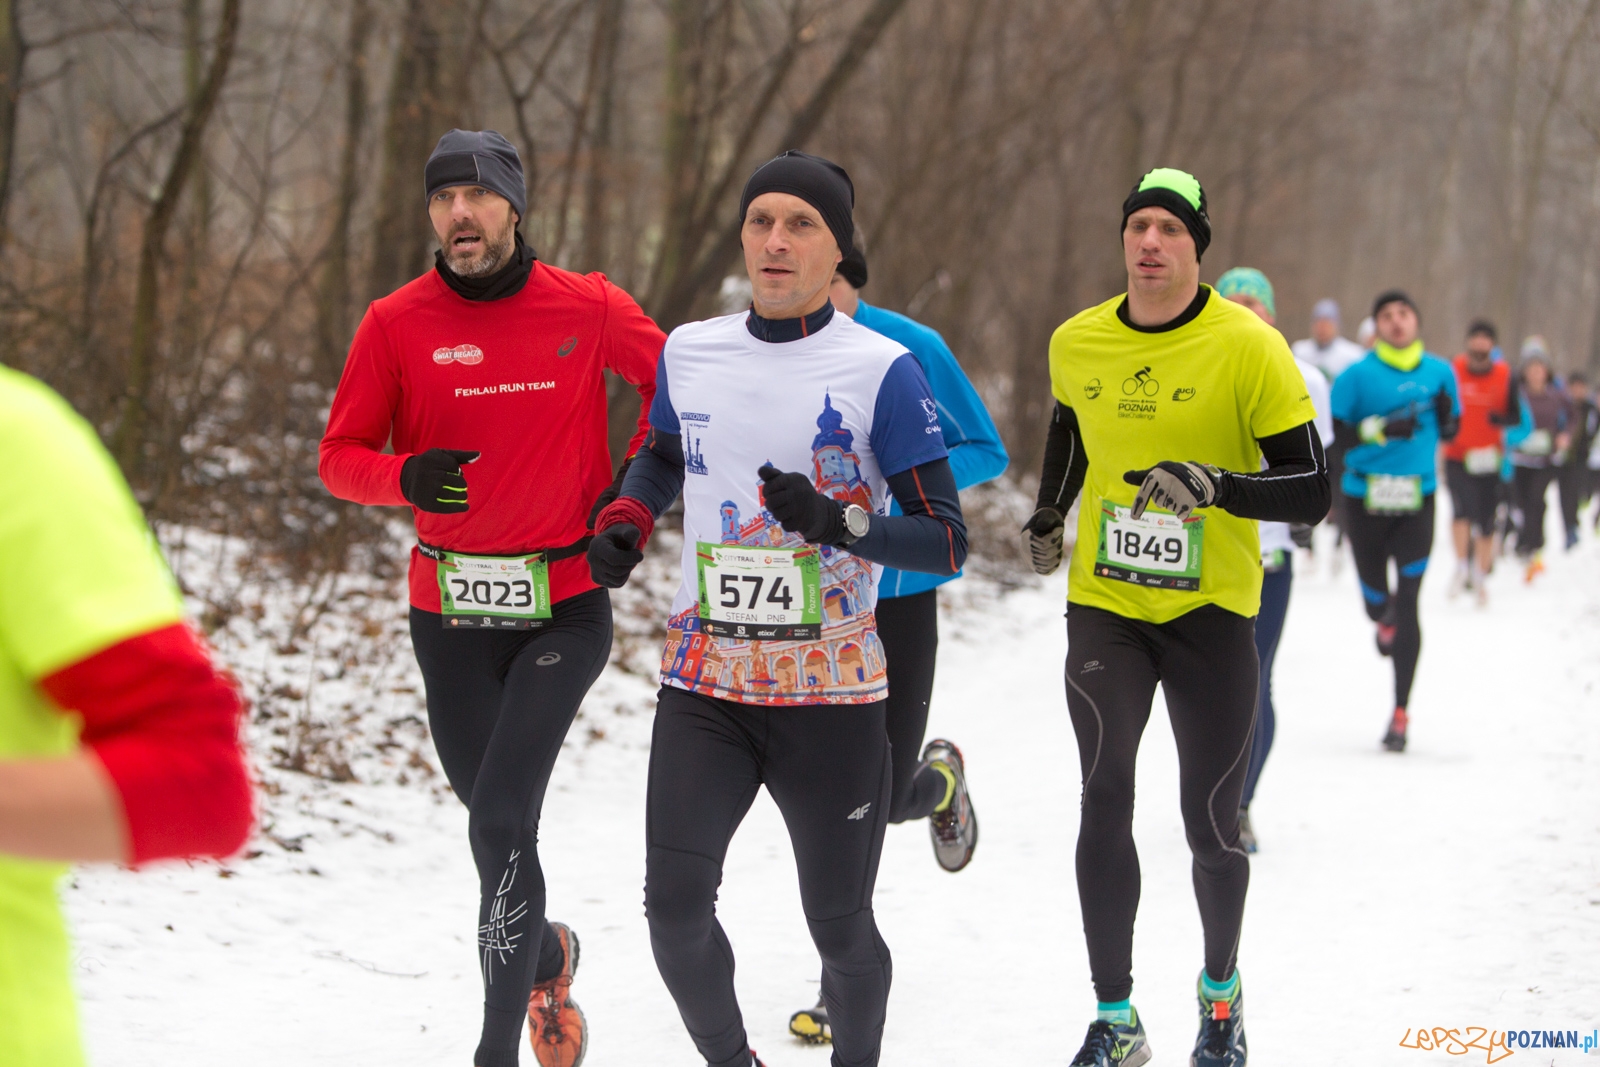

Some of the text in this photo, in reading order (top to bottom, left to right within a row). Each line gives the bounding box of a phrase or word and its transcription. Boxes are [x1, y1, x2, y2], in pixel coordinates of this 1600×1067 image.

[499, 382, 525, 393] RUN
[527, 381, 555, 390] TEAM
[1113, 529, 1183, 564] 1849
[451, 579, 532, 608] 2023
[720, 574, 793, 610] 574
[726, 612, 786, 623] STEFAN PNB
[847, 802, 871, 820] 4F
